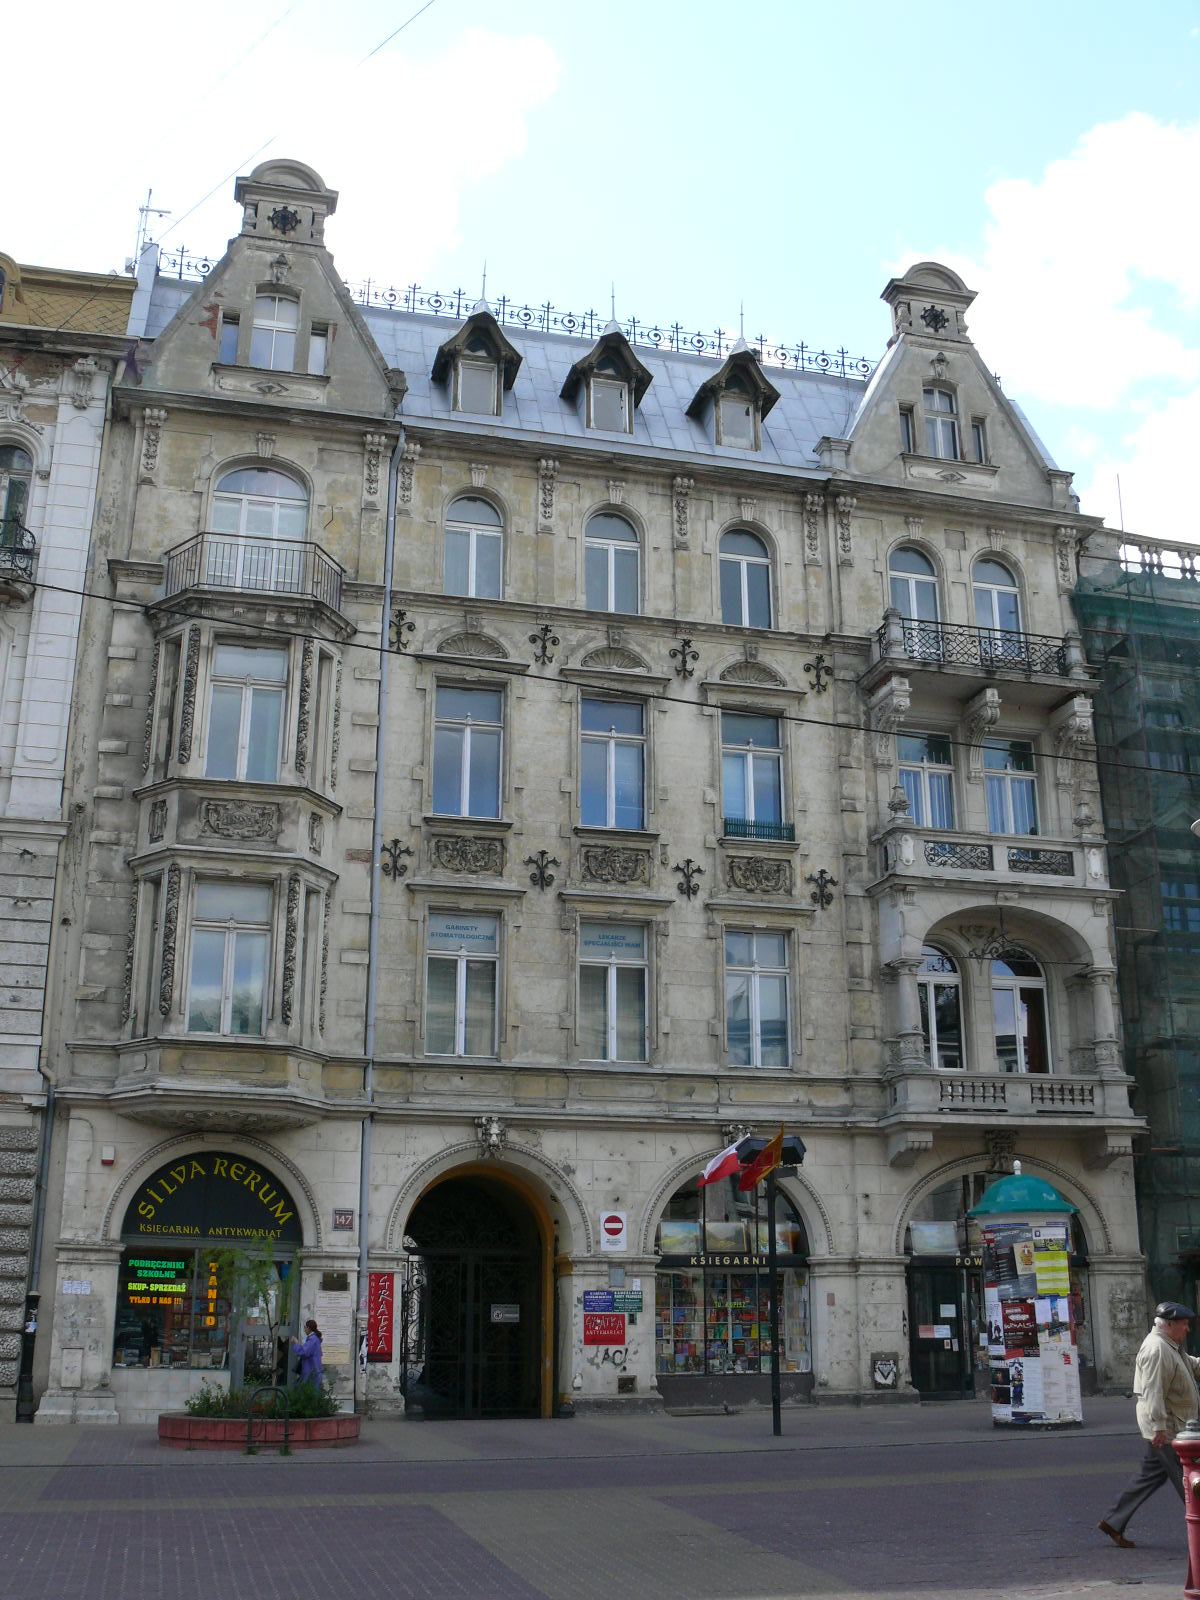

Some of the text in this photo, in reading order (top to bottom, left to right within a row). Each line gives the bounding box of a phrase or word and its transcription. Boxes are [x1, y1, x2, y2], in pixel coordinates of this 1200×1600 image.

[213, 1157, 293, 1225] RERUM
[335, 1215, 352, 1225] 147
[208, 1227, 283, 1238] ANTYKWARIAT
[690, 1256, 767, 1265] KSIEGARNI
[136, 1269, 176, 1279] SZKOLNE
[205, 1262, 219, 1326] TANIO
